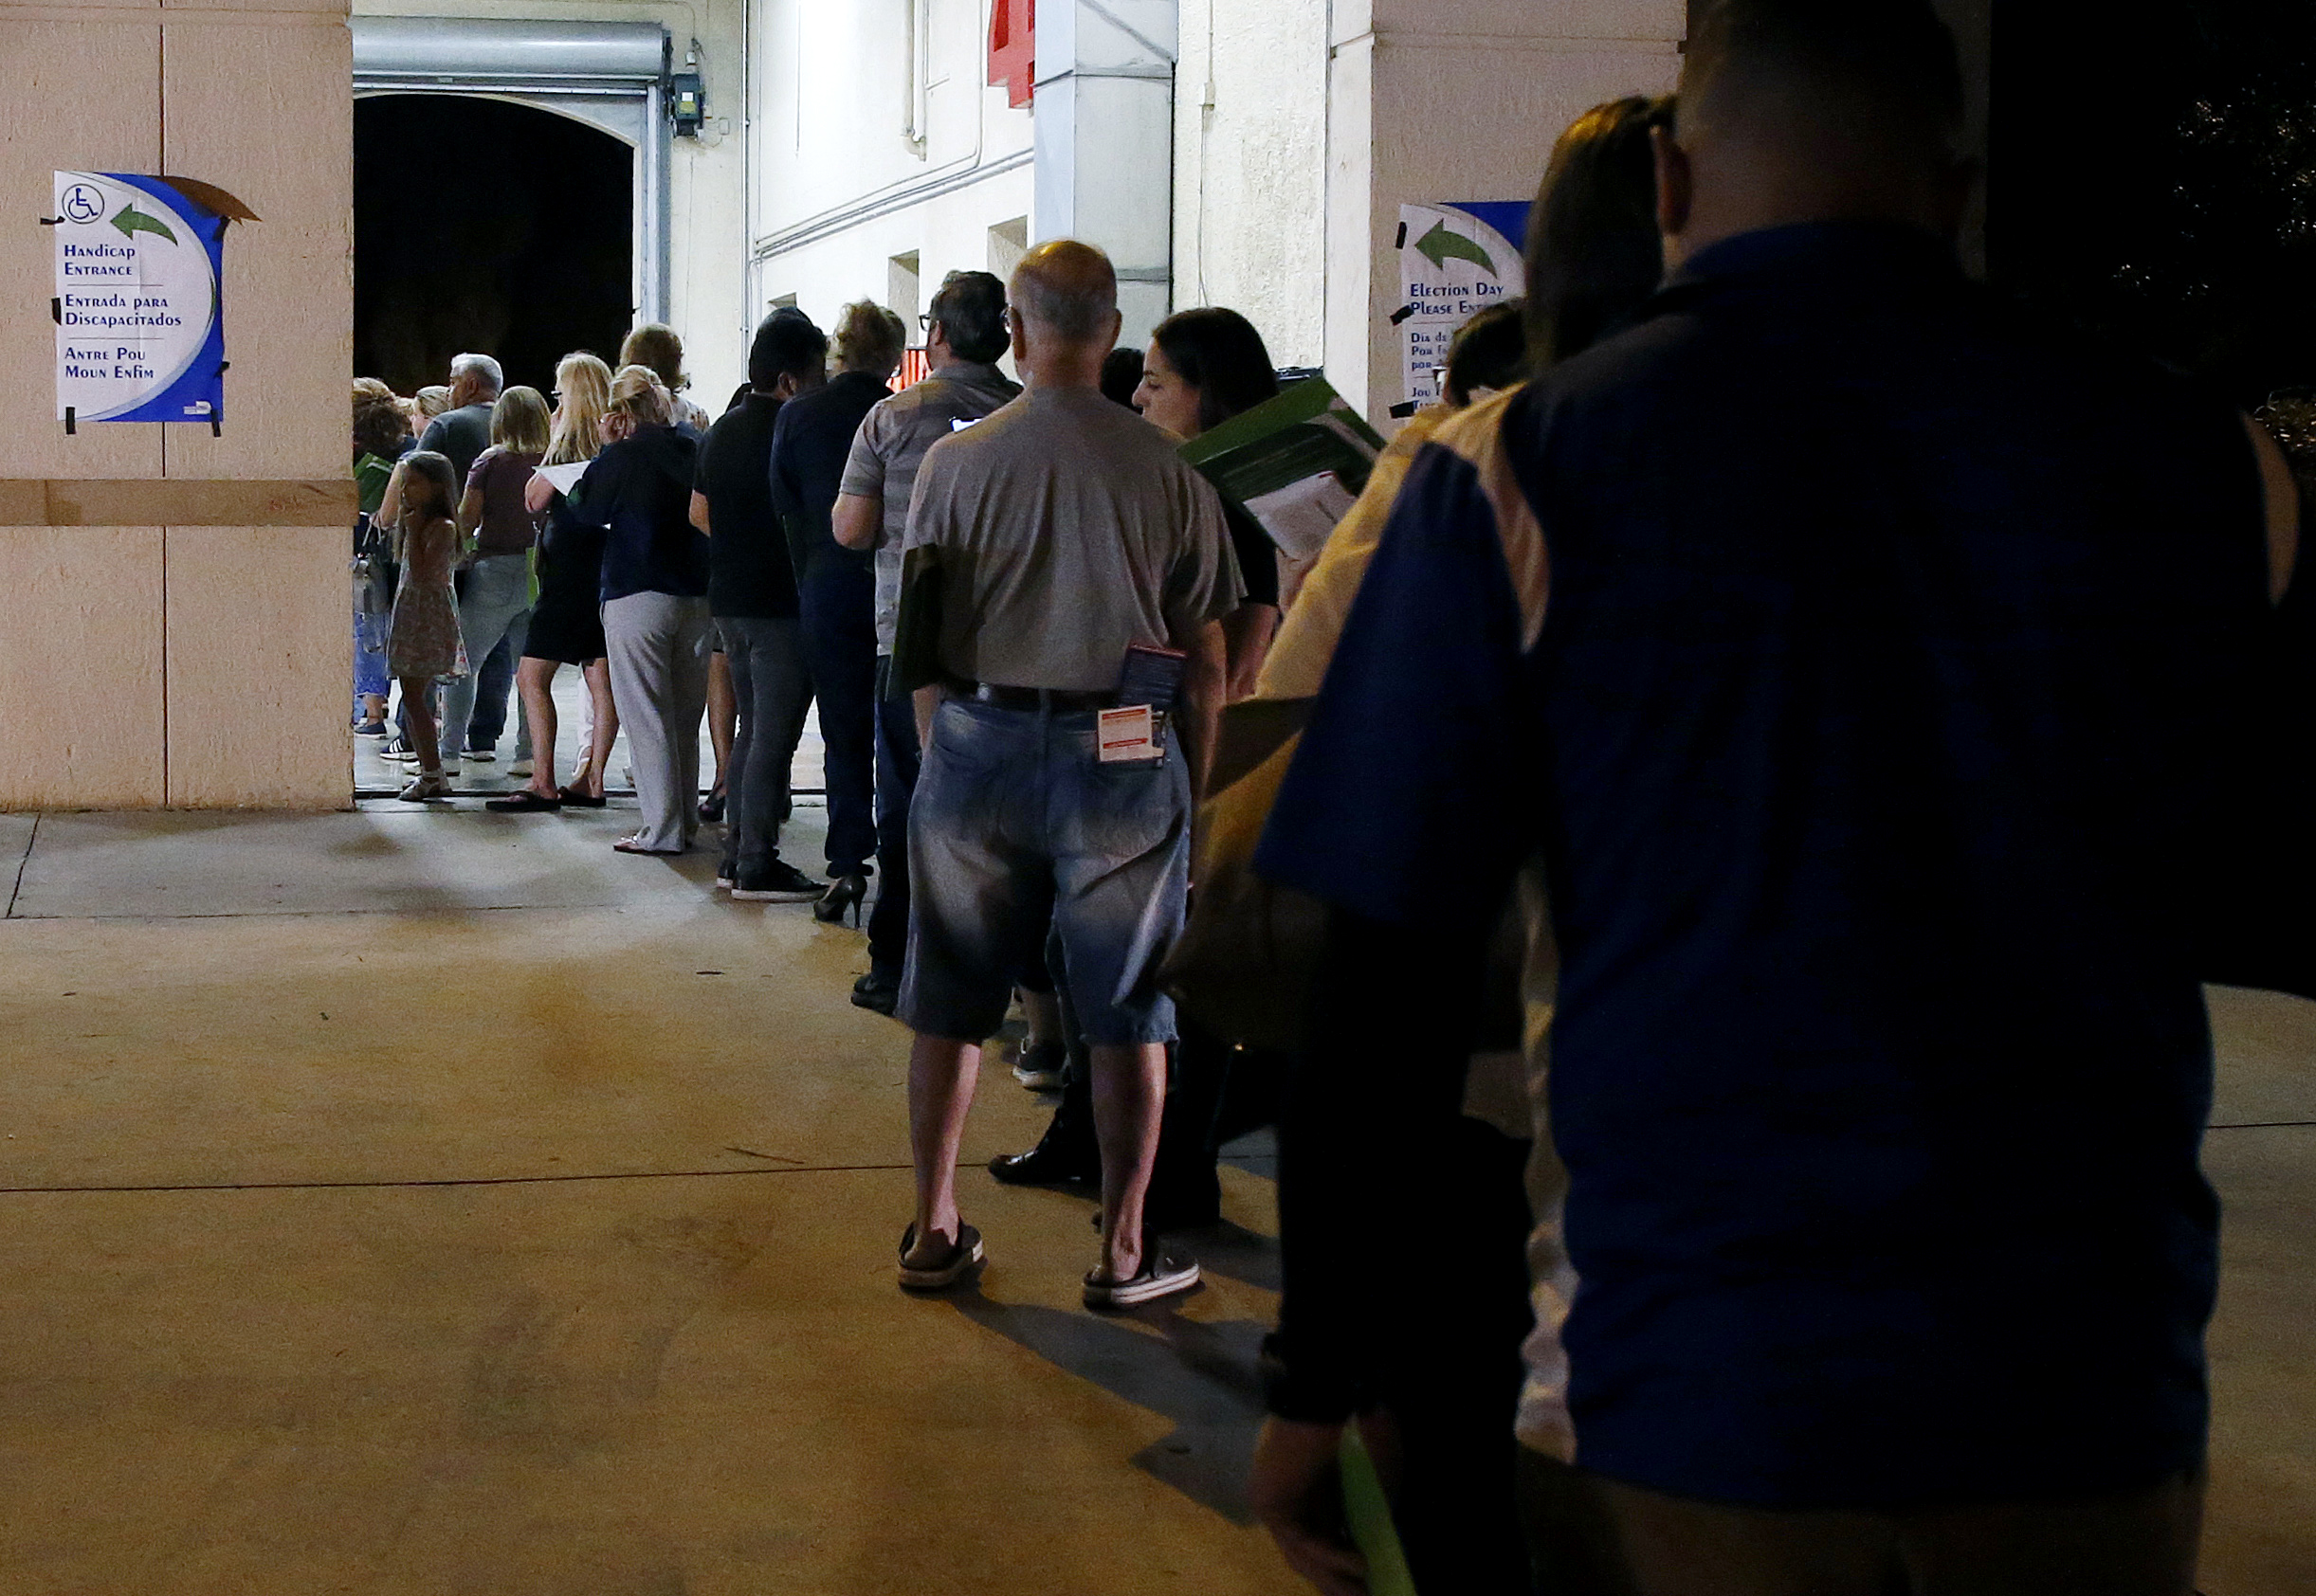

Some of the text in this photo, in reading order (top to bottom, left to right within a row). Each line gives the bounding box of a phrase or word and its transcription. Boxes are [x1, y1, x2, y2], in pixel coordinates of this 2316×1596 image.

[64, 245, 136, 260] Handicap
[64, 262, 133, 276] Entrance
[1411, 282, 1504, 297] Election Day
[65, 293, 169, 310] Entrada para
[1411, 300, 1452, 315] Please
[65, 312, 182, 328] Discapacitados
[64, 347, 146, 360] Antre Pou
[65, 364, 154, 378] Moun Enfim
